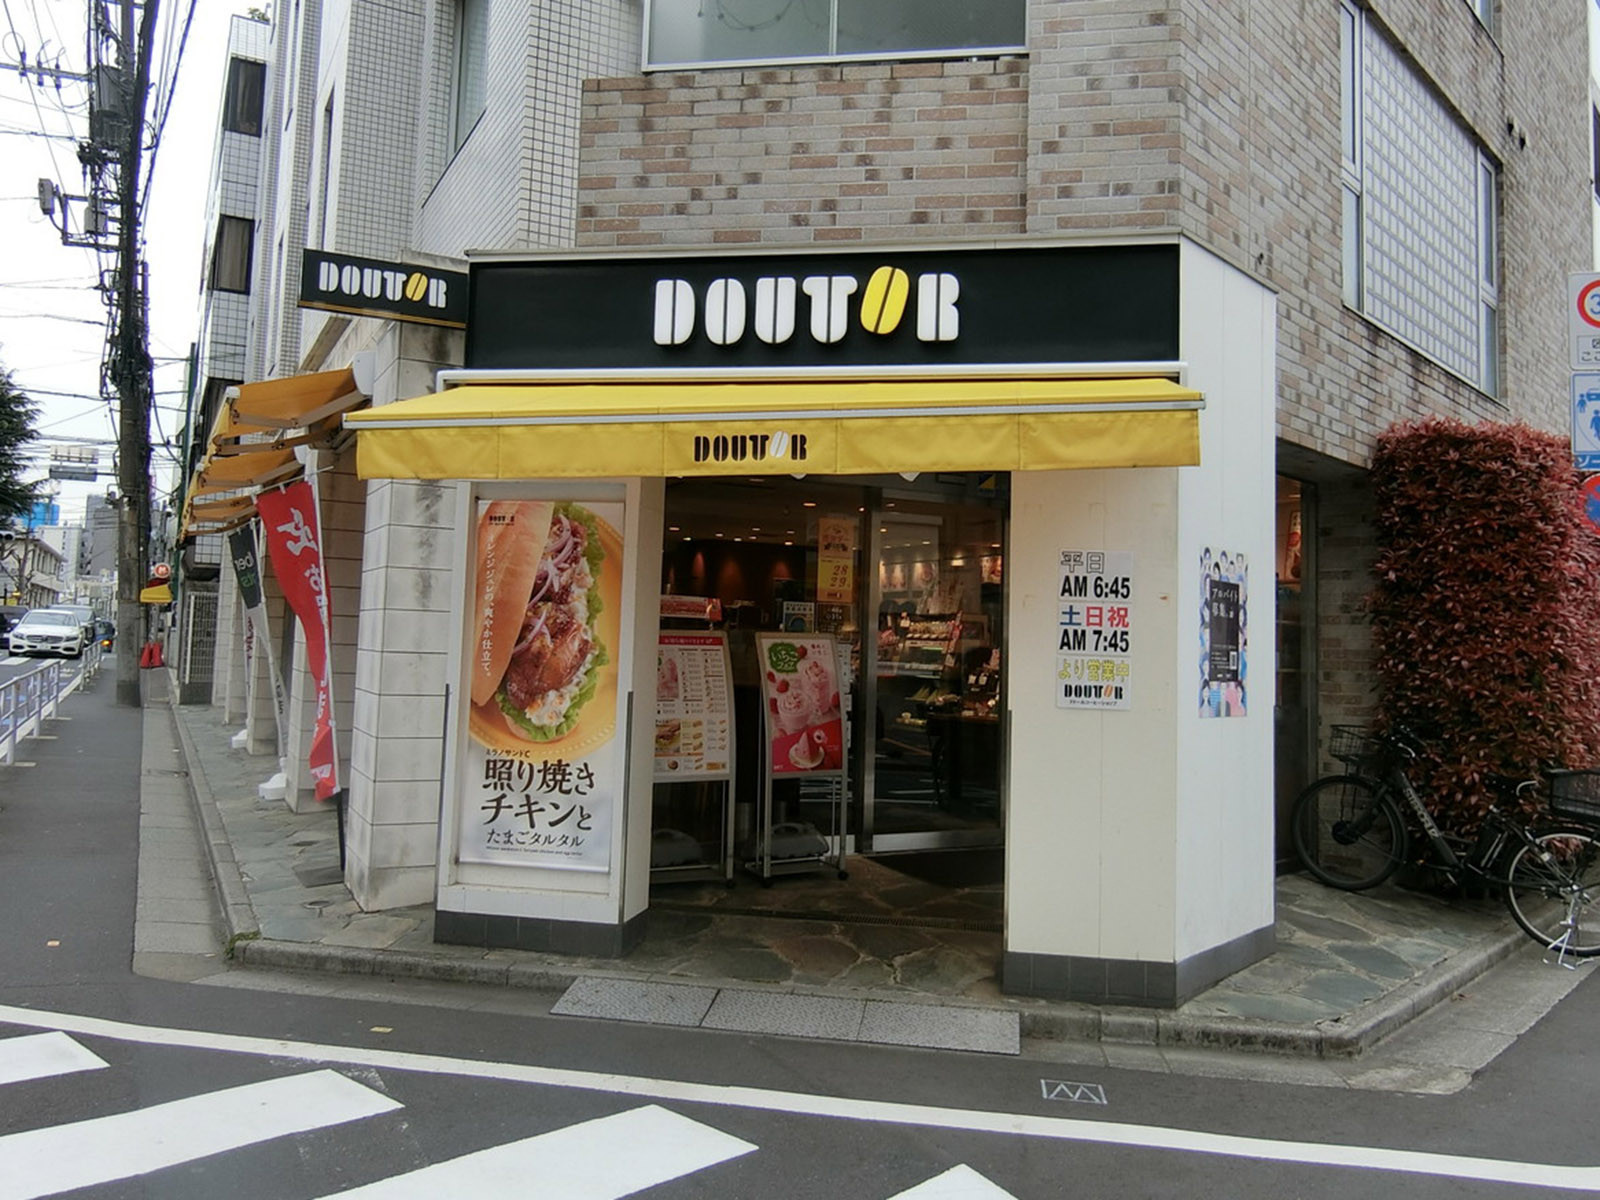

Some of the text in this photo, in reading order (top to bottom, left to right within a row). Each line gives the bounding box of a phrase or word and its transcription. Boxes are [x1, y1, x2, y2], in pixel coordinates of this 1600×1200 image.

[319, 261, 447, 308] DOUTOR
[653, 266, 960, 345] DOUTOR
[1590, 293, 1600, 315] 3
[1581, 351, 1600, 361] ここ
[694, 431, 807, 462] DOUTOR
[1577, 455, 1600, 468] ソー
[1060, 550, 1105, 574] 平日
[1060, 575, 1130, 599] AM 6:45
[1060, 605, 1129, 628] 土日祝
[1059, 628, 1129, 653] AM 7:45
[1058, 658, 1130, 683] より営業中
[1064, 684, 1123, 700] DOUTOR
[482, 758, 594, 795] 照り焼き
[481, 793, 592, 830] チキンと
[487, 828, 585, 848] たまごタルタル
